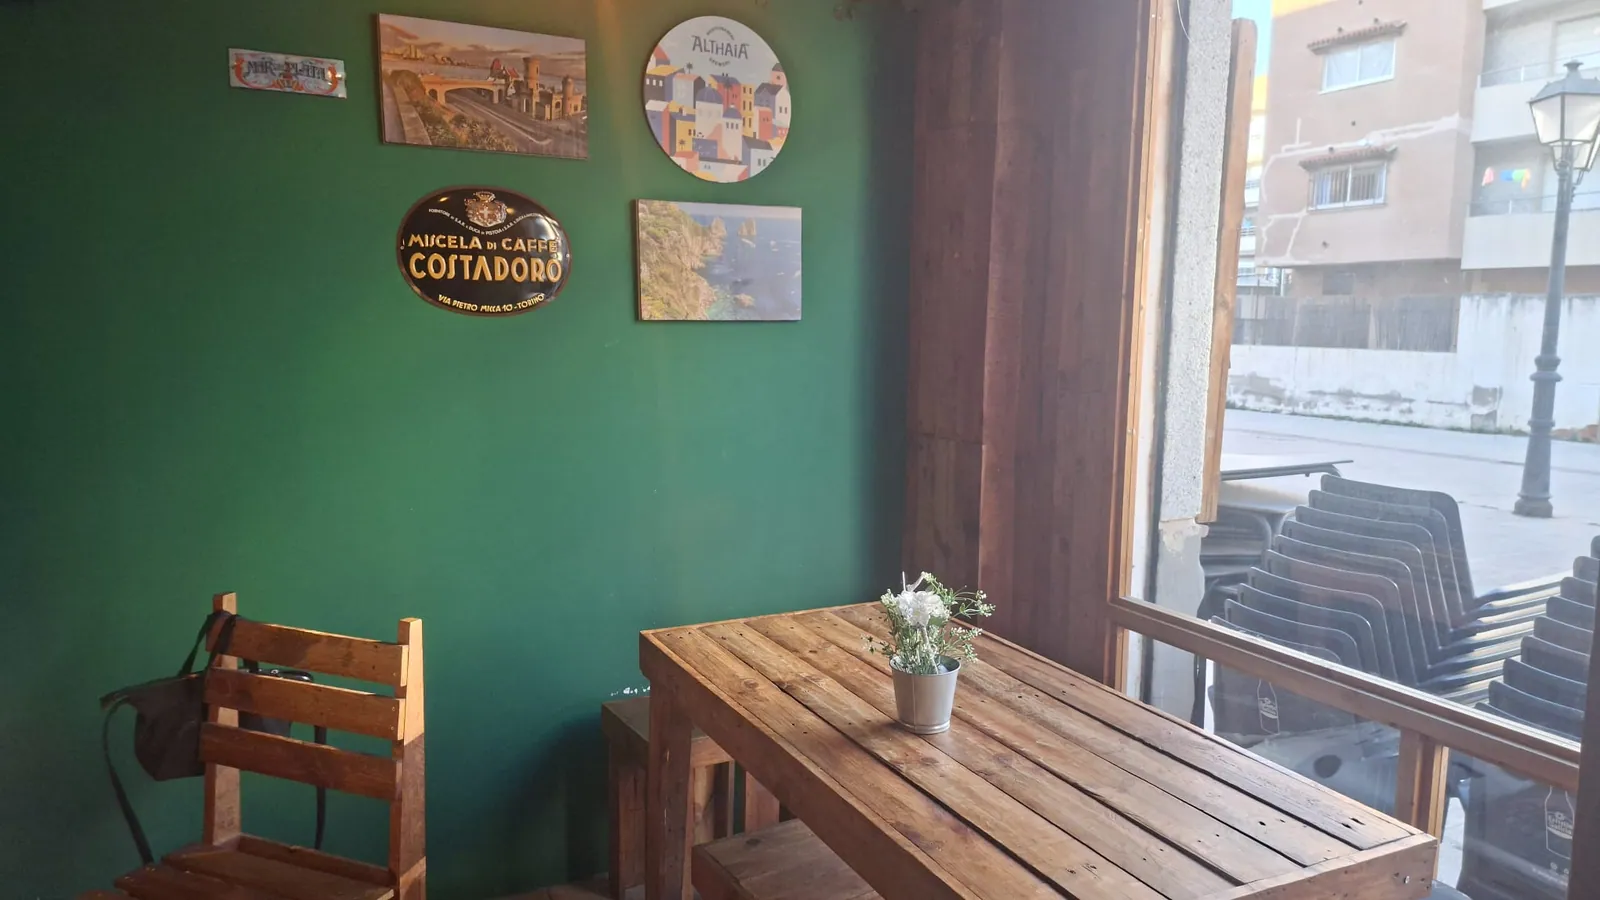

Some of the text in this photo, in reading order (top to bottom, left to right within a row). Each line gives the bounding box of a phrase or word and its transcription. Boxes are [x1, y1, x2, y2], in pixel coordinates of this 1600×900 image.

[691, 34, 750, 60] ALTHAIA
[407, 234, 482, 250] MISCELA
[486, 241, 497, 250] DI
[409, 252, 562, 283] COSTADORO
[438, 294, 451, 306] VIA
[452, 300, 478, 312] PIETRO
[480, 304, 501, 313] MICCA
[501, 303, 513, 312] 10
